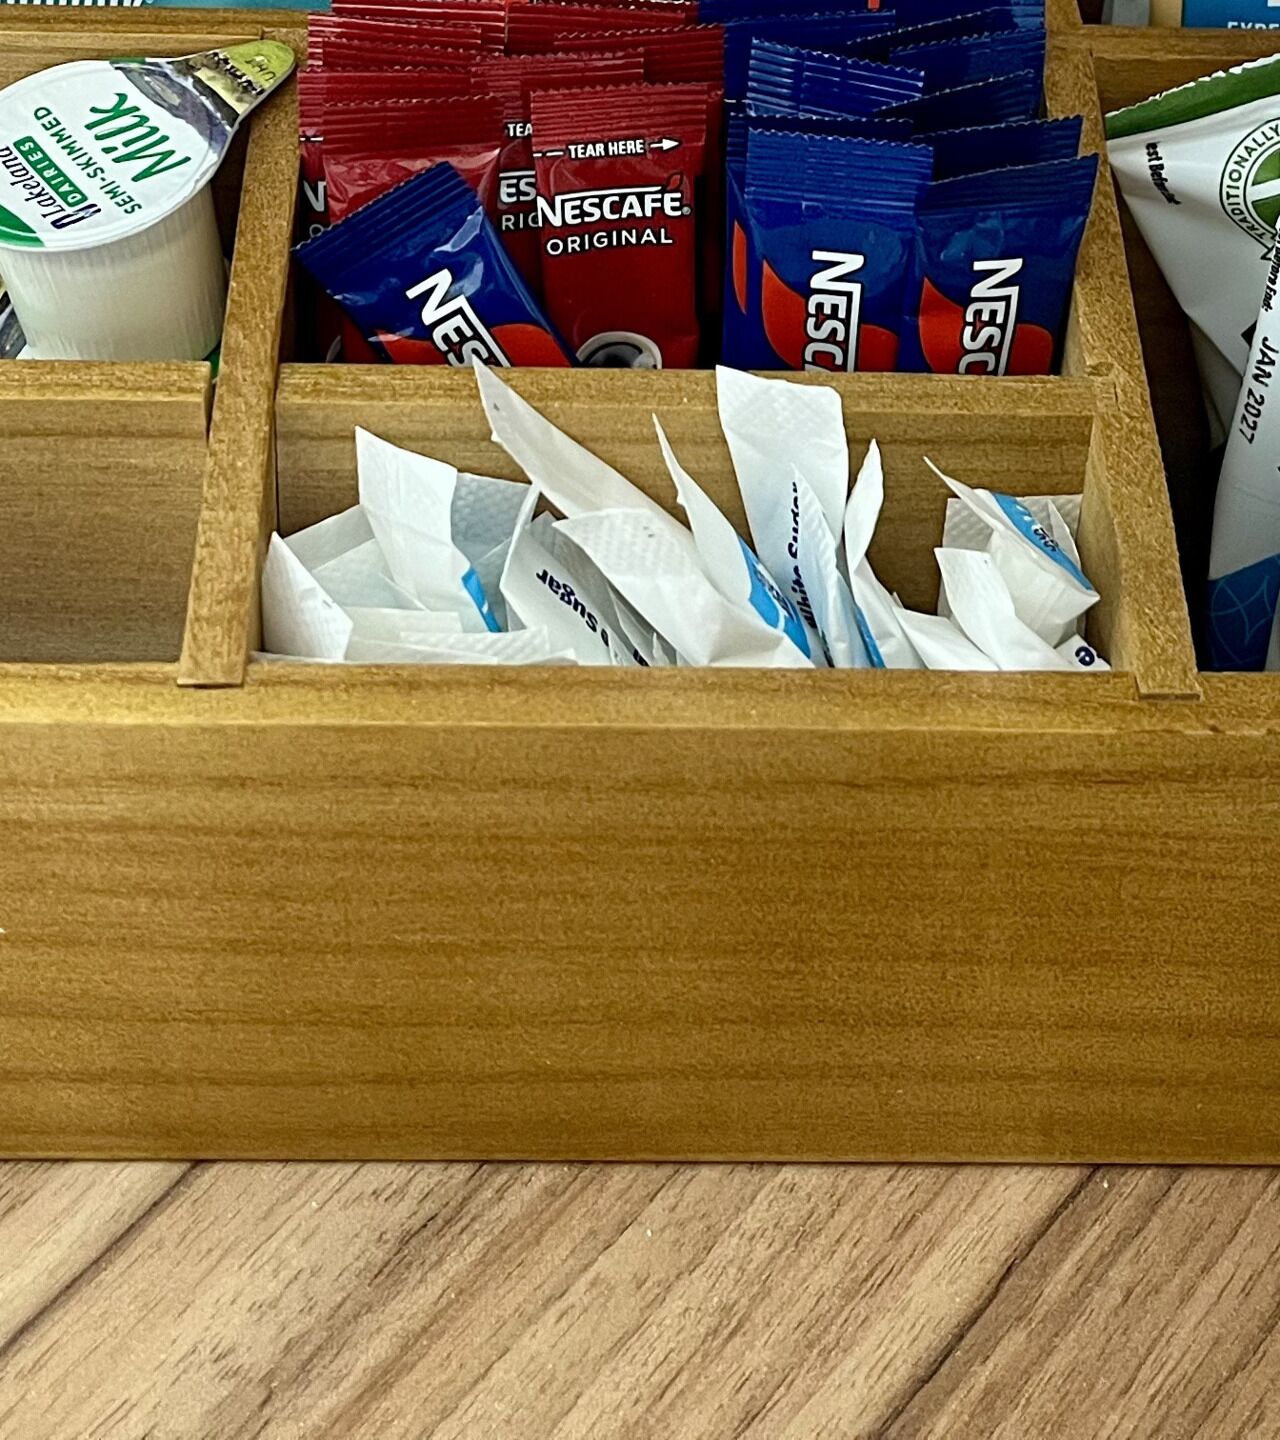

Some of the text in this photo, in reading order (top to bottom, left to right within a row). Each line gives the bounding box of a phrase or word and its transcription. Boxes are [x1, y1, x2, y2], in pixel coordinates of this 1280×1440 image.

[19, 141, 80, 203] DAIRIES
[33, 106, 143, 215] SEMI-SKIMMED
[84, 92, 192, 183] Milk
[568, 139, 645, 159] TEAR HERE
[1226, 125, 1280, 240] TRADITIONALLY
[546, 227, 673, 256] ORIGINAL
[1239, 336, 1280, 445] JAN 2027
[535, 568, 599, 633] Sugar
